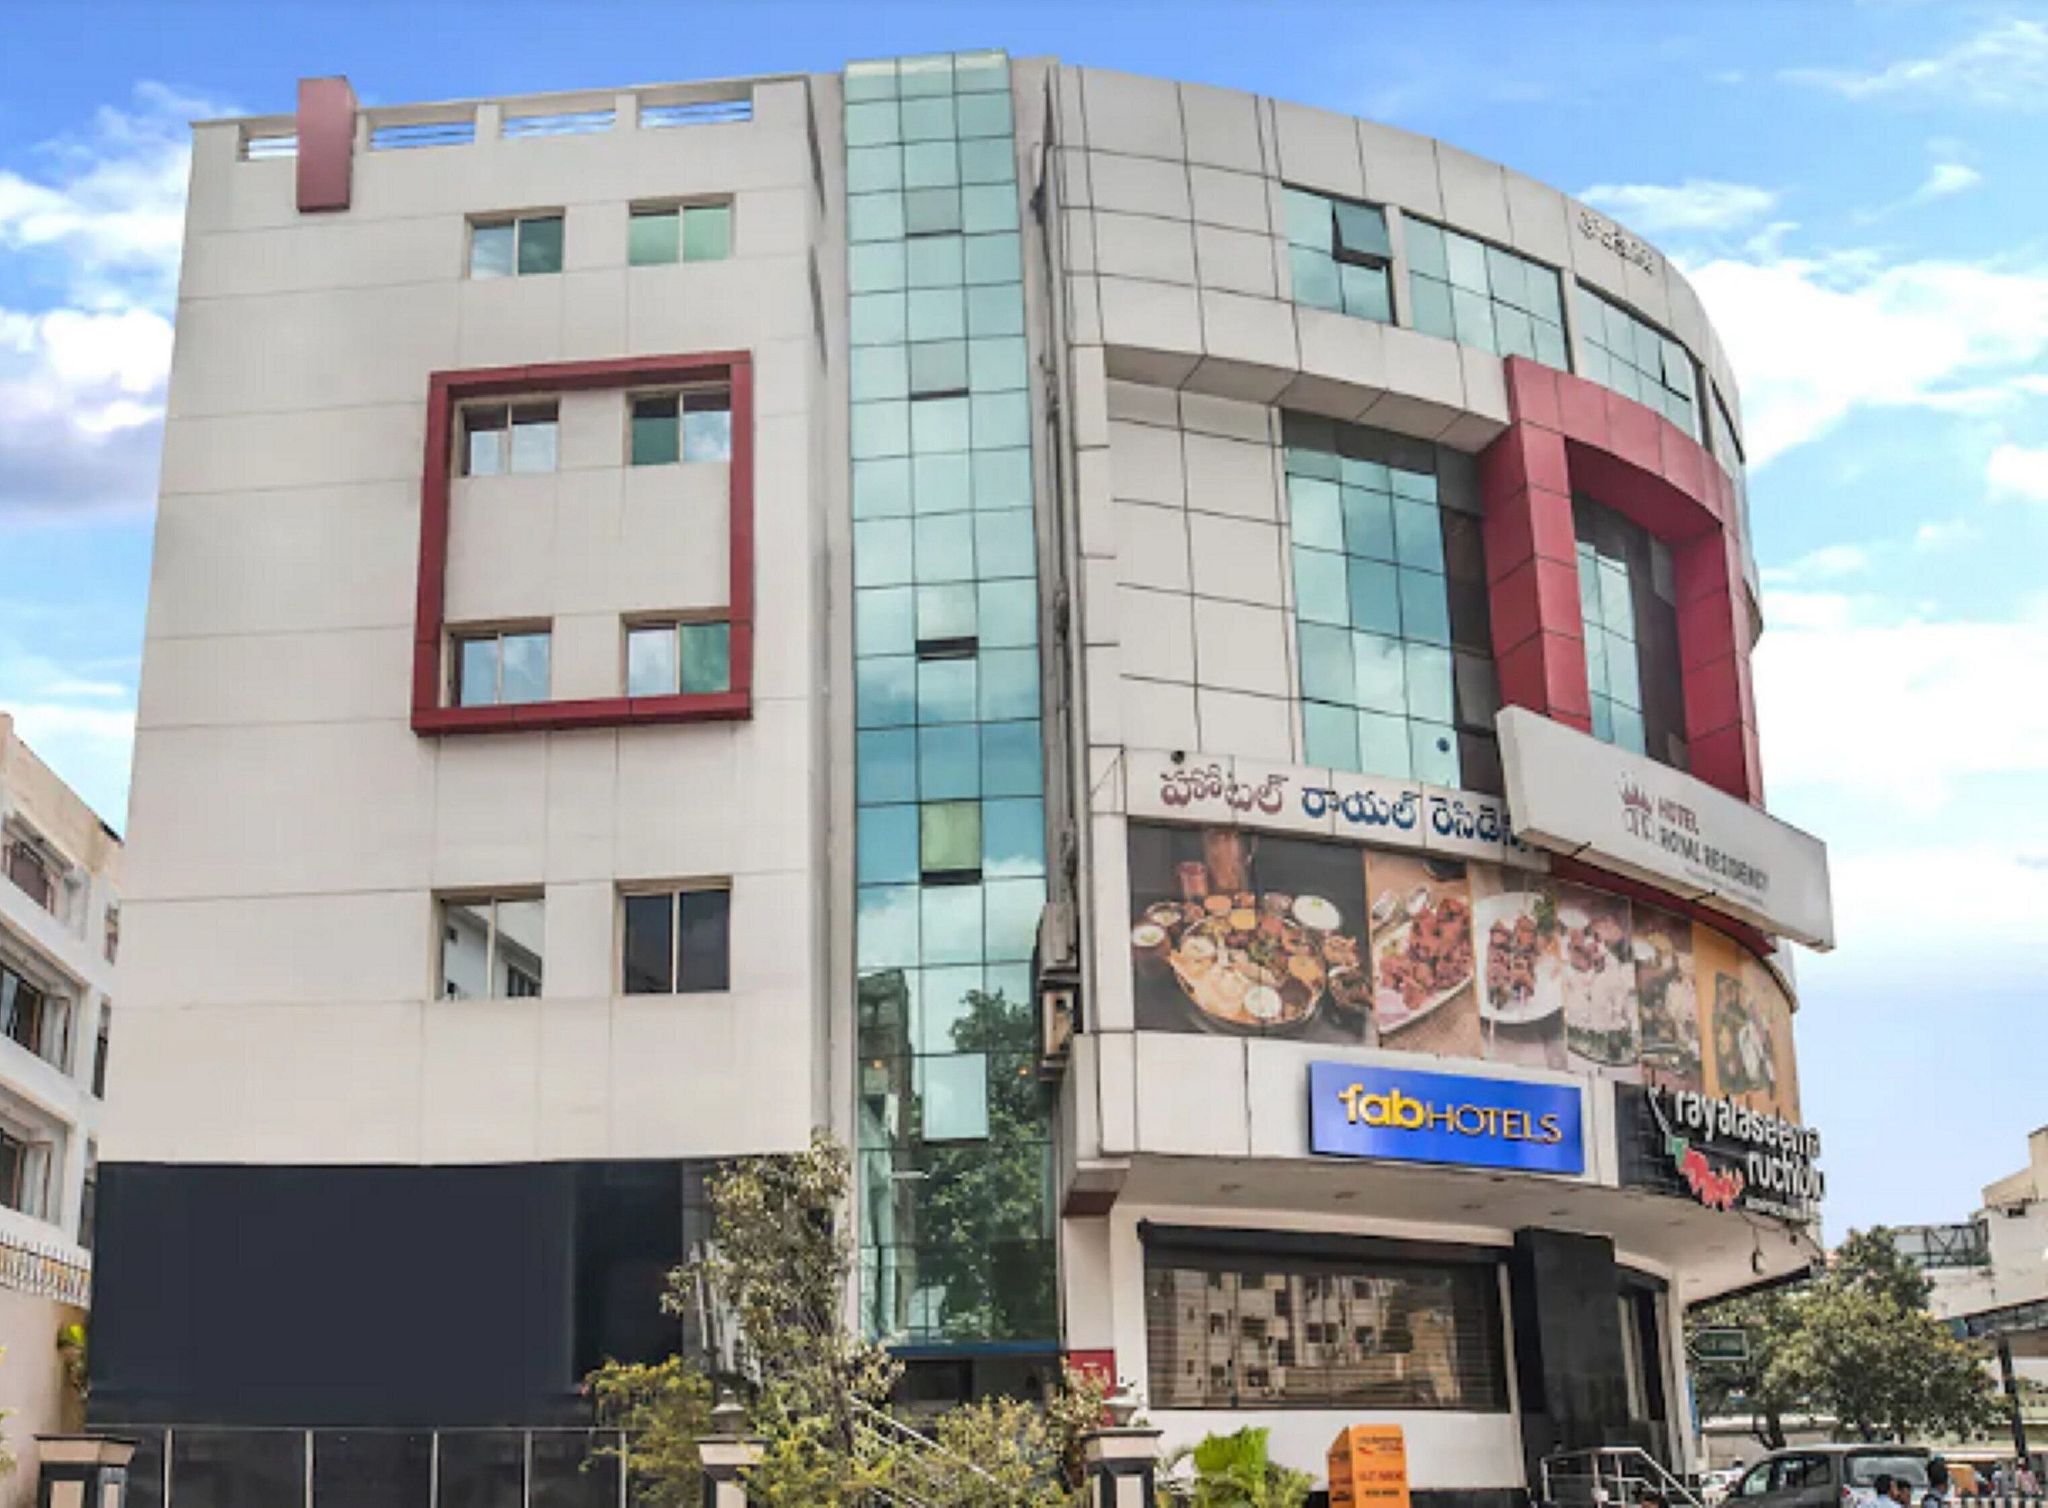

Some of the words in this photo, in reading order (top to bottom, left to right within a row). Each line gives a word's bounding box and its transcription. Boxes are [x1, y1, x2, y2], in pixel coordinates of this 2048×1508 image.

[1301, 787, 1421, 829] రాయల్
[1658, 796, 1699, 836] HOTEL
[1659, 824, 1700, 864] ROYAL
